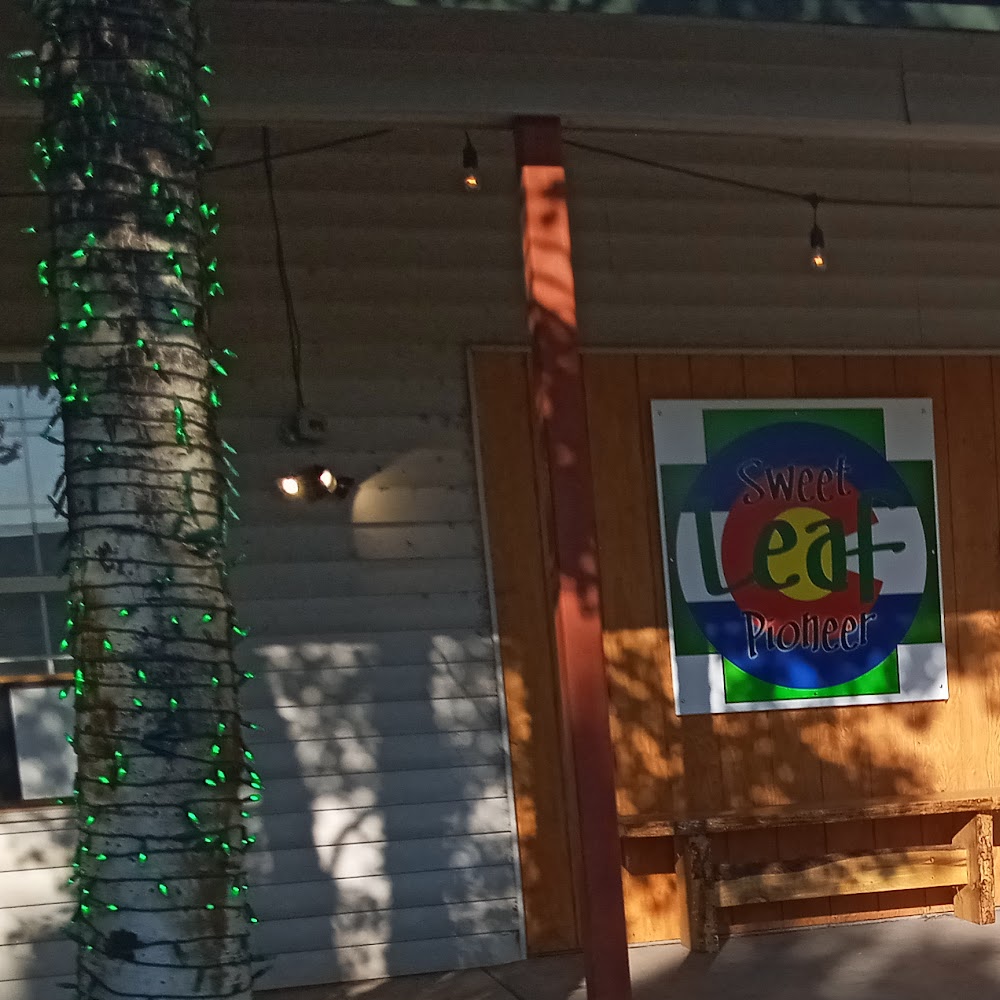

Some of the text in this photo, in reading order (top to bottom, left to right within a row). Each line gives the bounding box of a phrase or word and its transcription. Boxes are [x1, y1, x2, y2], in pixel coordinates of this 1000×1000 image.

[737, 457, 852, 504] Sweet
[694, 489, 906, 603] Leaf
[743, 612, 876, 659] Pioneer
